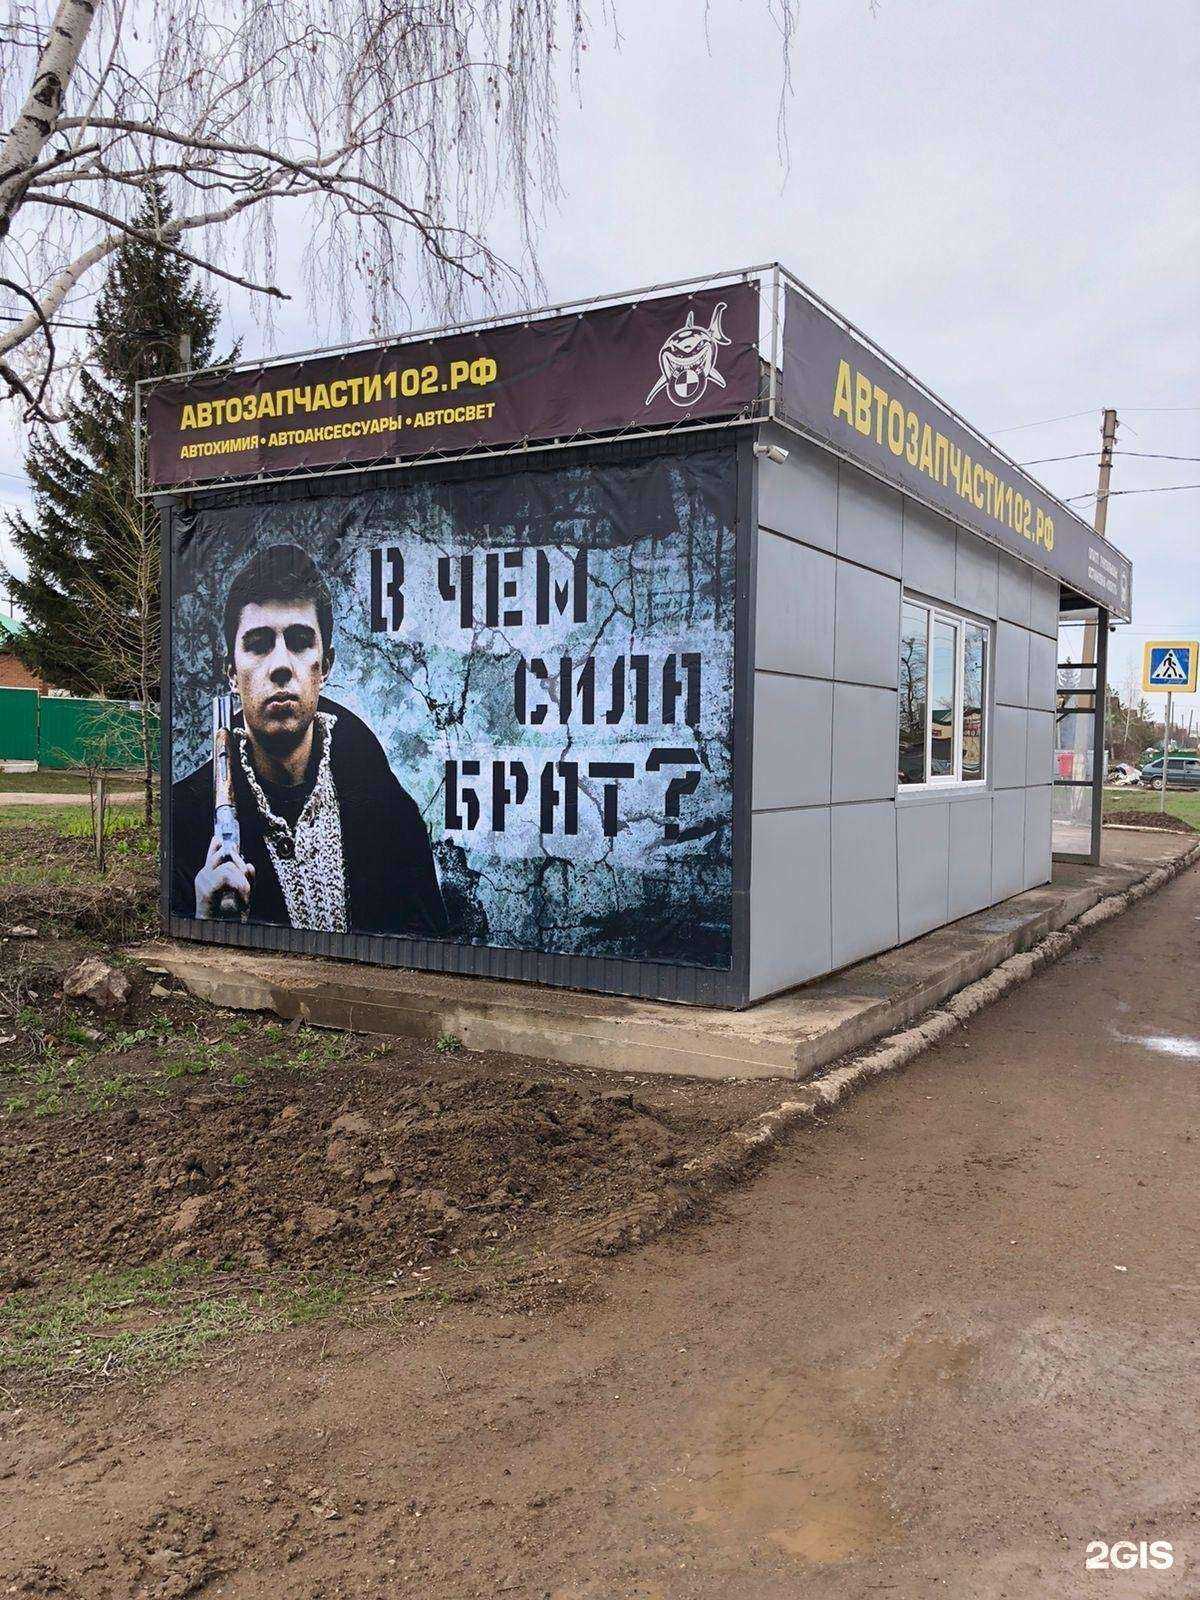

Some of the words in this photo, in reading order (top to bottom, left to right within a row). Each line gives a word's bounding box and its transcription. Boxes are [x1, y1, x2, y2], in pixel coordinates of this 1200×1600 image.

[180, 357, 498, 431] АВТОЗАПЧАСТИ102.РФ
[180, 434, 259, 459] АВТОХИМИЯ
[268, 414, 402, 447] АВТОАКСЕССУАРЫ
[413, 402, 496, 428] АВТОСВЕТ
[832, 359, 1054, 552] АВТОЗАПЧАСТИ102.РФ
[370, 547, 405, 632] В
[437, 549, 588, 629] ЧЕМ
[513, 653, 701, 725] СИЛА
[444, 747, 701, 840] БРАТ?
